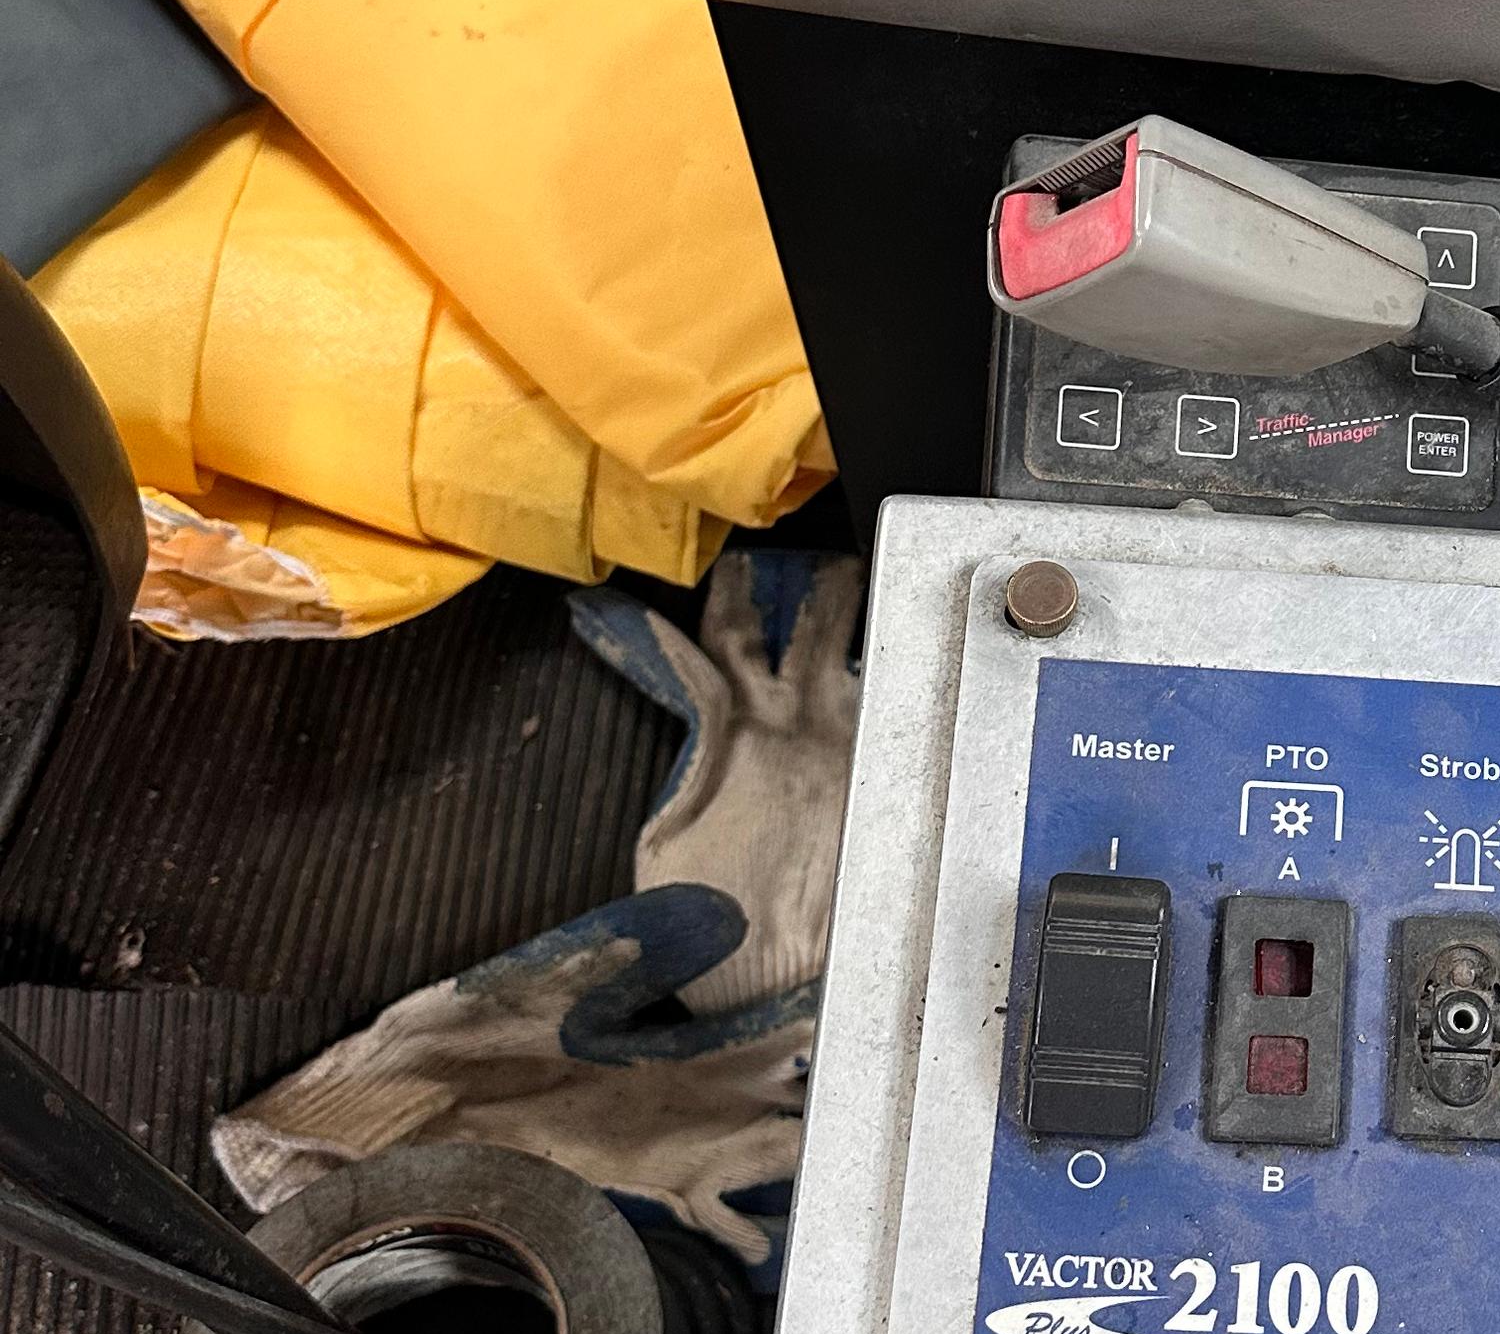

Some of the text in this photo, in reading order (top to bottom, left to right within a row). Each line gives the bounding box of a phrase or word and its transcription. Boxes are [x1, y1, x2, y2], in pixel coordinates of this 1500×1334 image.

[1416, 431, 1460, 445] POWER
[1418, 444, 1458, 457] ENTER
[1071, 733, 1175, 762] Master
[1265, 744, 1329, 771] PTO
[1277, 856, 1301, 882] A
[1262, 1165, 1285, 1193] B
[1004, 1252, 1158, 1291] VACTOR
